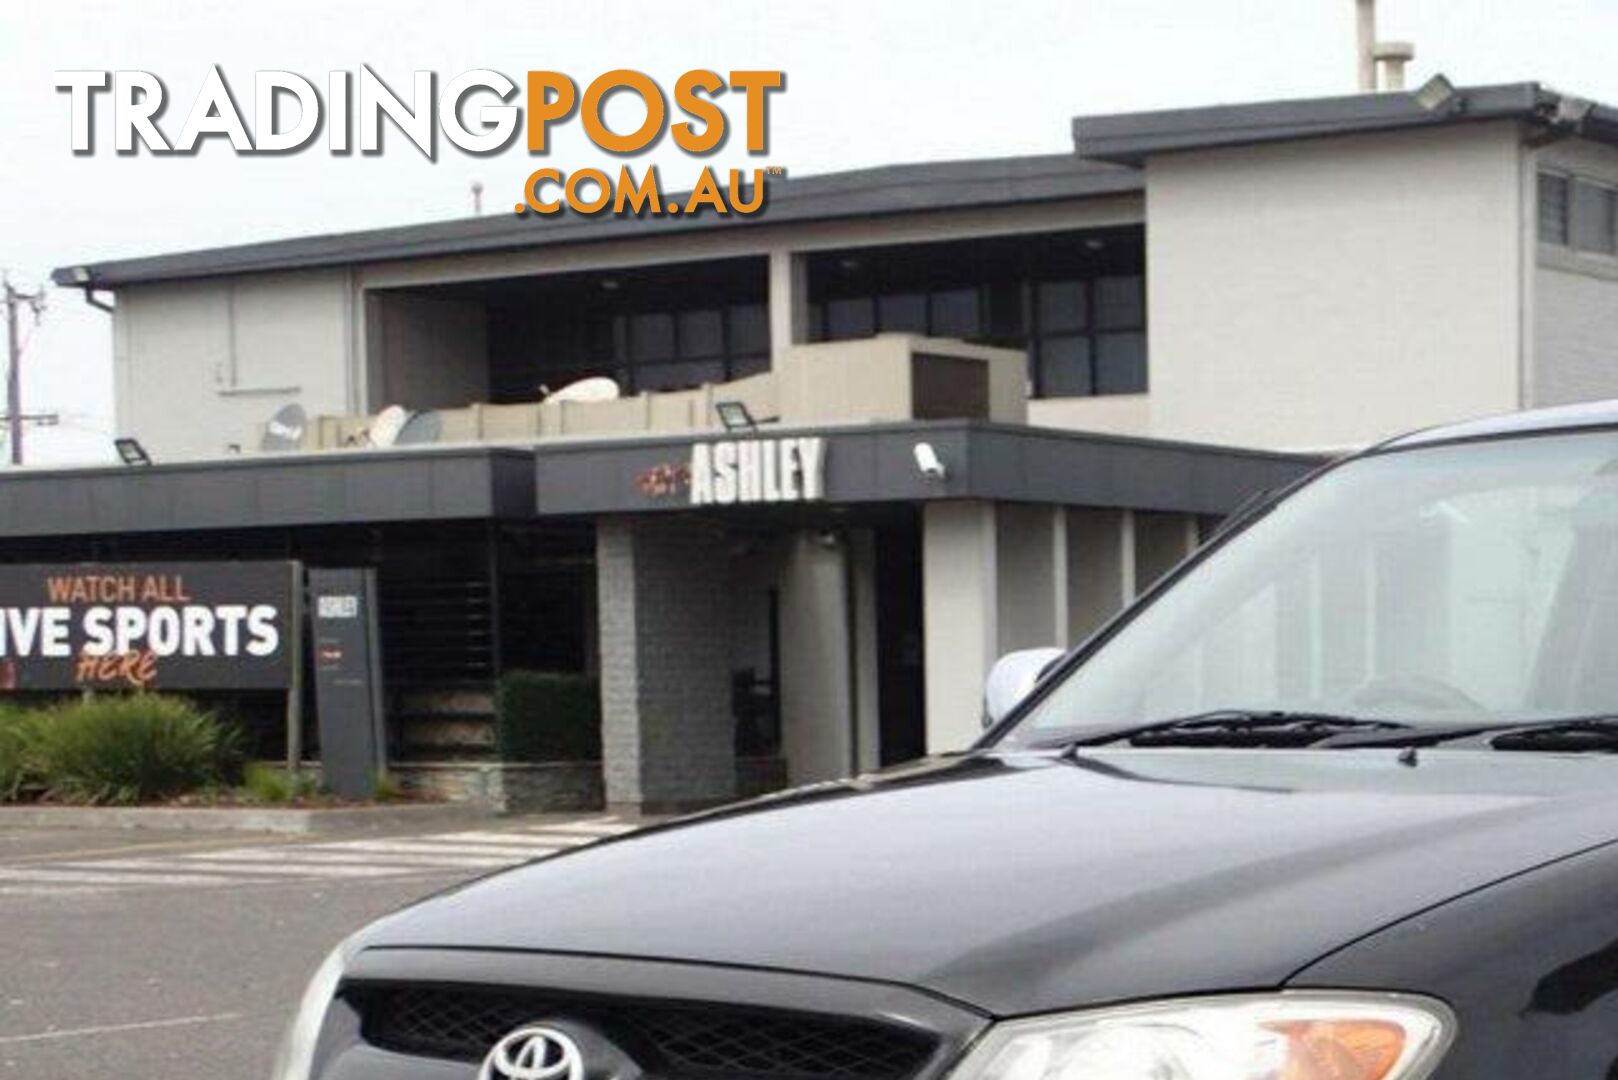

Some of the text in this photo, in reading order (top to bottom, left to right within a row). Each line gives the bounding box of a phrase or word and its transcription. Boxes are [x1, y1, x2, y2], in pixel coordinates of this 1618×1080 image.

[690, 437, 827, 503] ASHLEY
[48, 575, 191, 601] WATCH ALL
[82, 605, 279, 657] SPORTS
[76, 650, 158, 686] HERE
